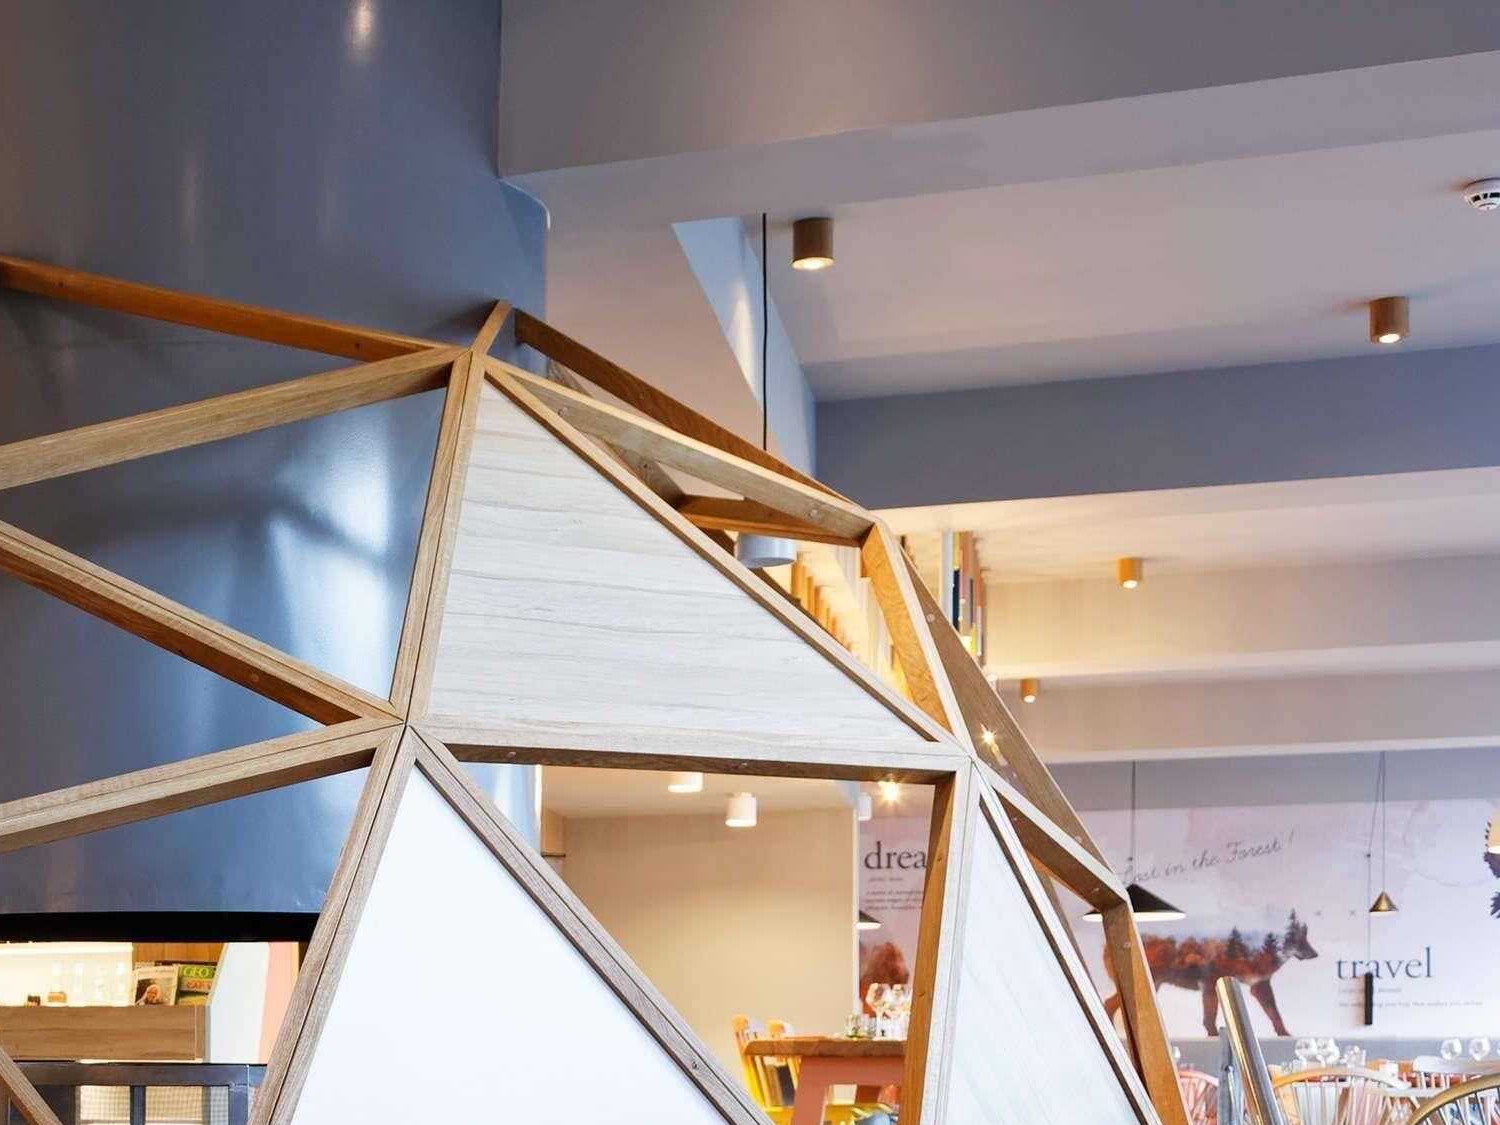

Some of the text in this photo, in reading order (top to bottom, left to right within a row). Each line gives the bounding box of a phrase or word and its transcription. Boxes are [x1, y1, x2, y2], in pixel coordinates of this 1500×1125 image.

[864, 840, 927, 870] drea
[1192, 850, 1220, 869] the
[1336, 946, 1433, 980] travel
